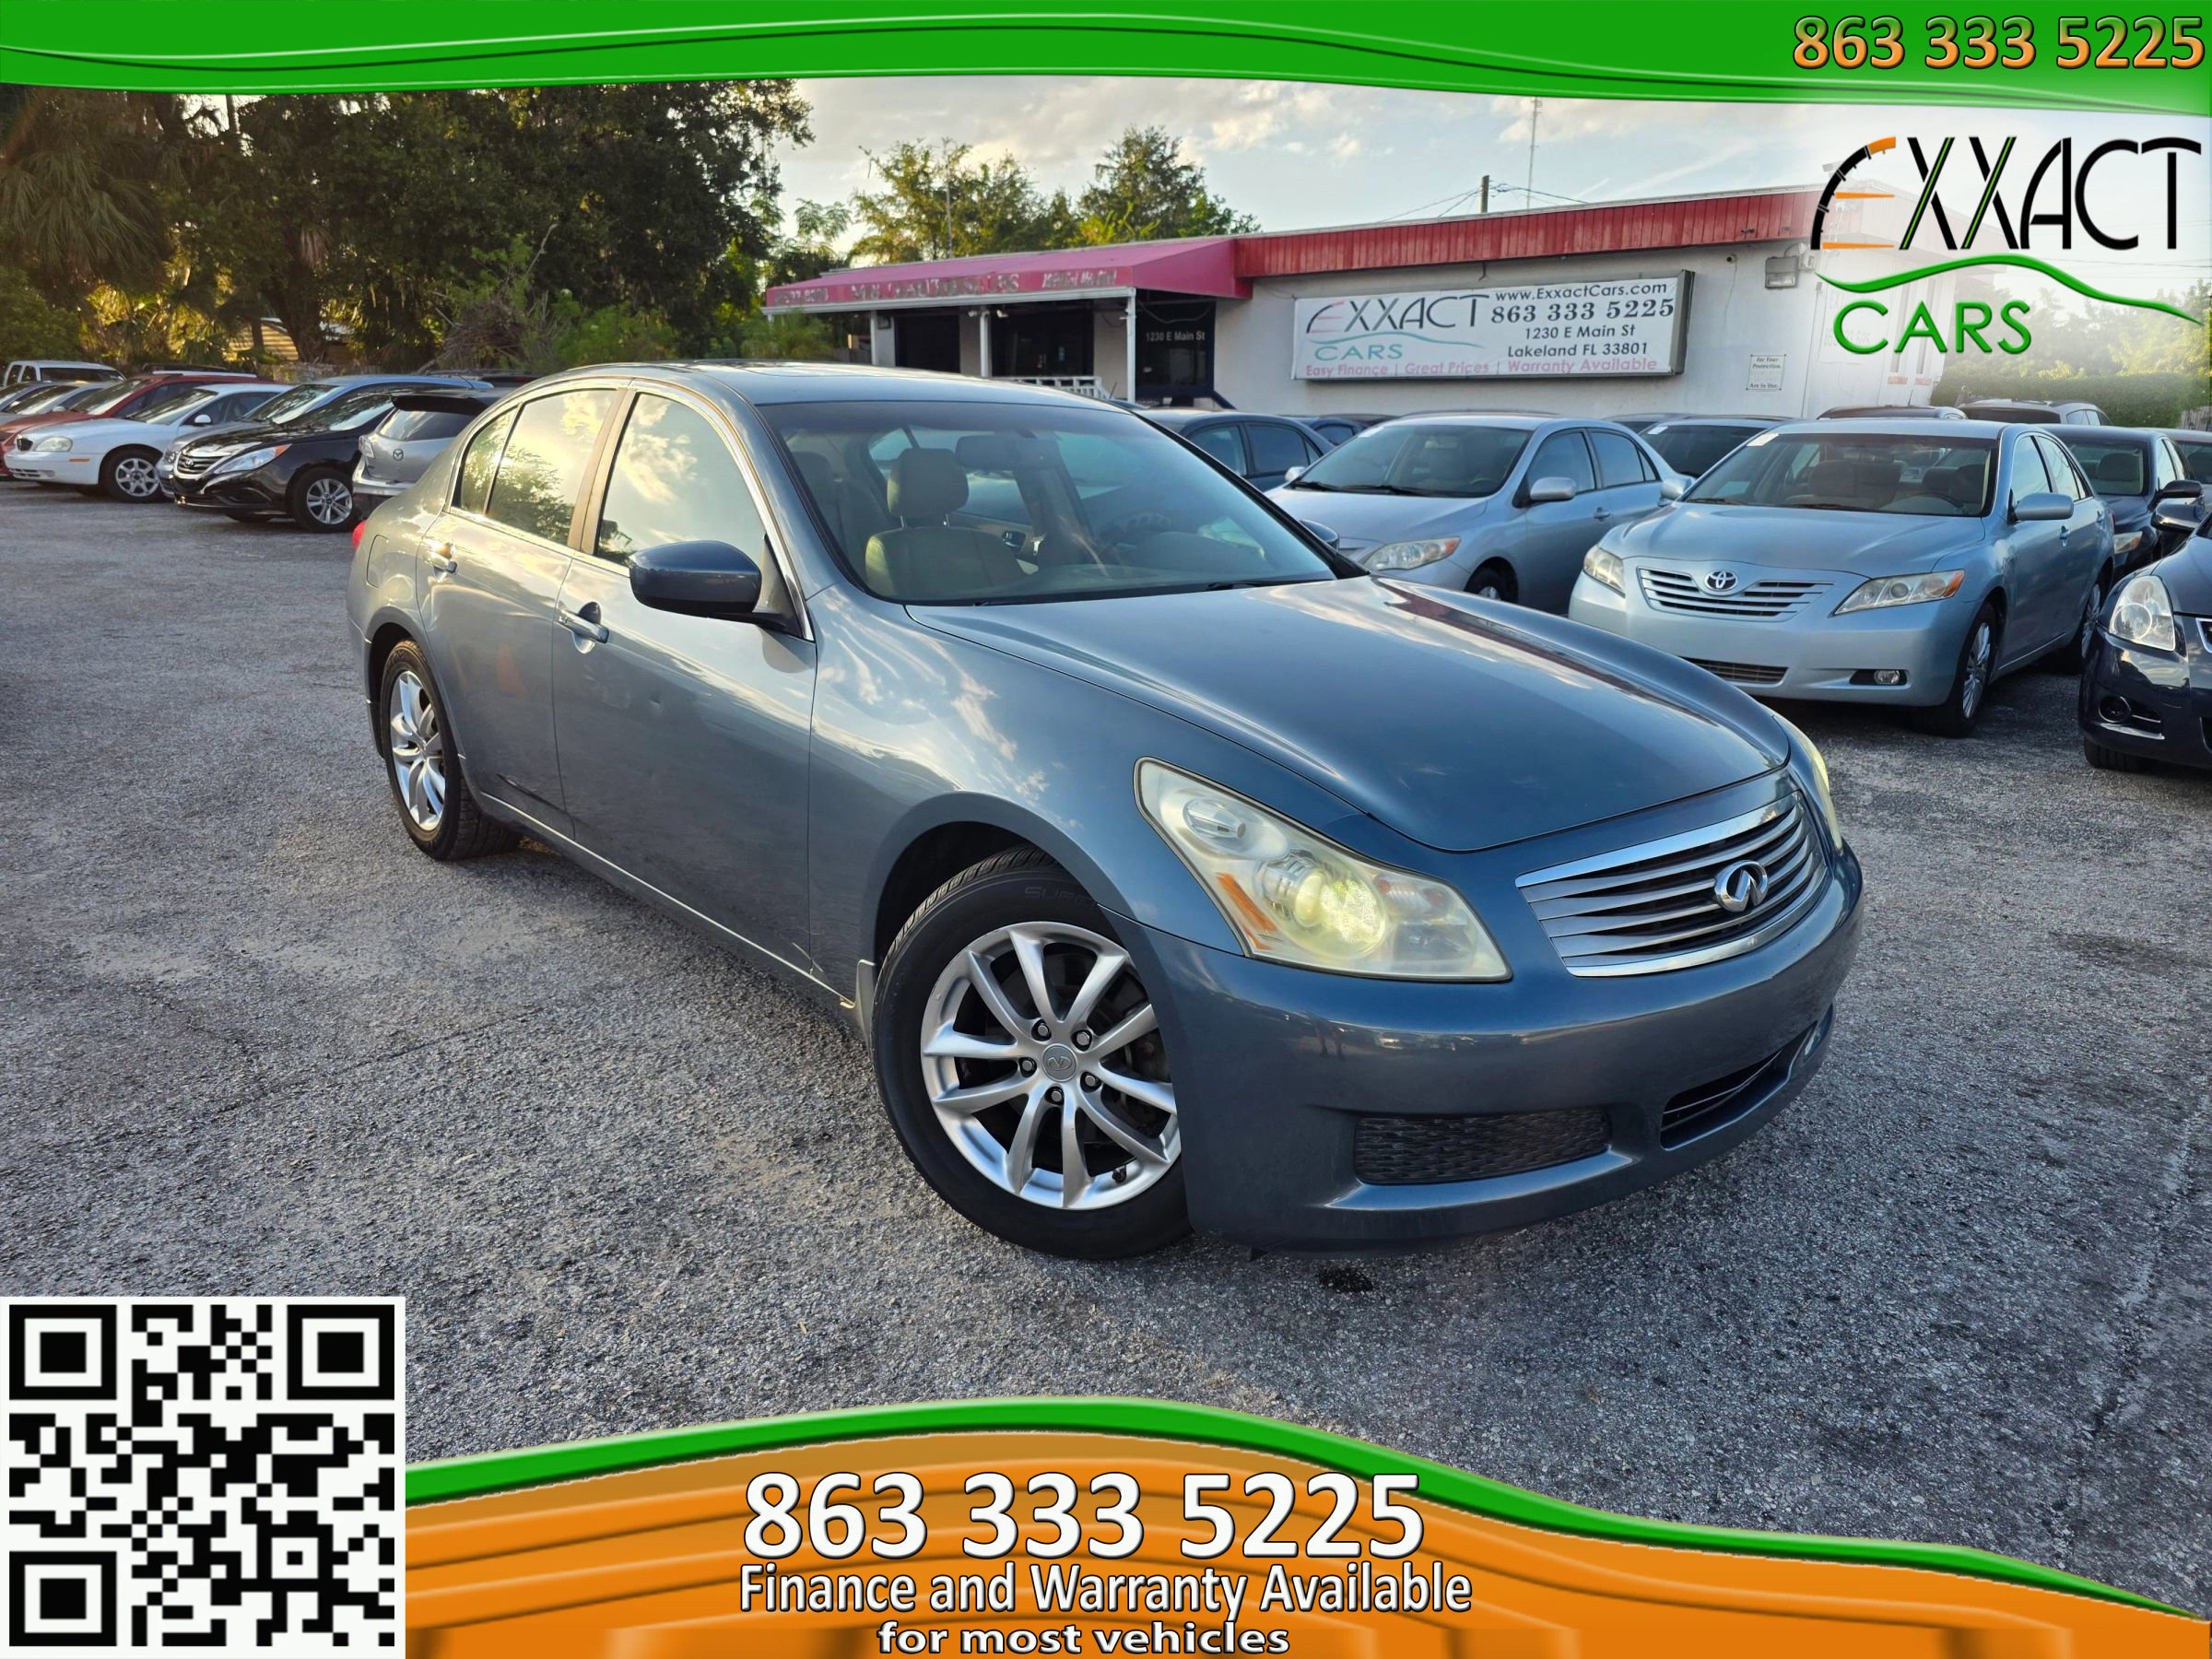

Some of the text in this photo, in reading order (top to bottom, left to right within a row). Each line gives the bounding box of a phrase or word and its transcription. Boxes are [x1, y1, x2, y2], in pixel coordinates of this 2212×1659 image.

[1495, 283, 1667, 301] www.ExxactCars.com
[1306, 294, 1489, 334] EXXACT
[1491, 298, 1675, 324] 863 333 5225
[1146, 331, 1206, 341] 1230 E Main St
[1525, 324, 1636, 339] 1230 E Main St
[1314, 344, 1403, 361] CARS
[1508, 342, 1648, 358] Lakeland FL 33801
[1306, 358, 1657, 378] Easy Finance Great Prices Warranty Available
